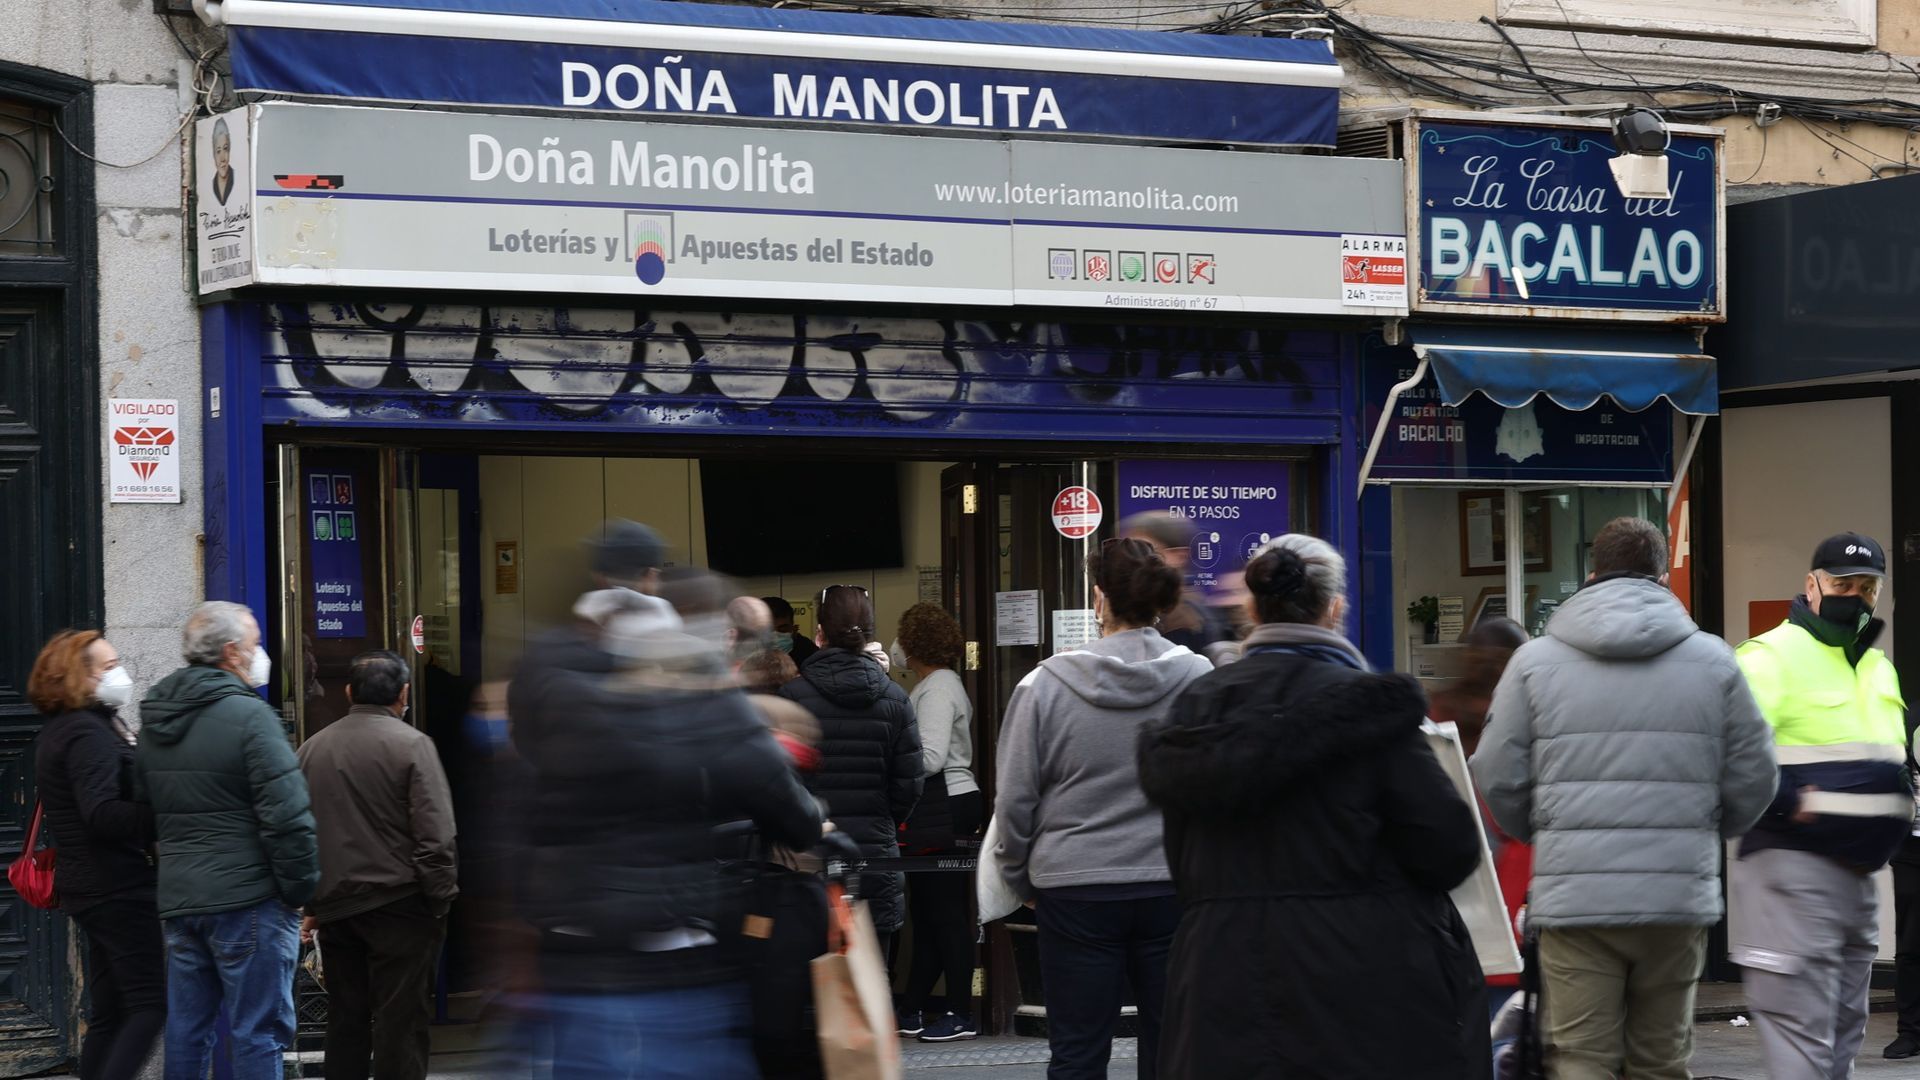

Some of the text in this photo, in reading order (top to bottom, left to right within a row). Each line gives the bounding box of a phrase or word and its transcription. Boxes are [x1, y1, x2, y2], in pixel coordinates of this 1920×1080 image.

[561, 56, 1068, 129] DOÑA MANOLITA
[468, 134, 815, 196] Doña Manolita
[1453, 155, 1508, 208] La
[1520, 158, 1607, 214] Casa
[935, 180, 1239, 214] www.loteriamanolita.com
[488, 226, 620, 262] Loterías y
[681, 234, 934, 269] Apuestas del Estado
[1342, 239, 1405, 252] ALARMA
[1431, 216, 1703, 288] BACALAO
[1372, 264, 1403, 273] LASSER
[1105, 294, 1187, 309] Administración
[1204, 297, 1218, 309] 67
[1347, 289, 1366, 299] 24h
[113, 404, 174, 415] VIGILADO
[1402, 406, 1459, 418] AUTENTICO
[1601, 414, 1614, 424] DE
[1399, 424, 1464, 442] BACALAO
[1575, 434, 1639, 445] IMPORTACION
[1061, 491, 1089, 509] +18
[1131, 485, 1276, 500] DISFRUTE DE SU TIEMPO
[1169, 506, 1240, 519] EN 3 PASOS
[316, 582, 351, 597] Loterías y
[317, 600, 362, 615] Apuestas del
[318, 619, 343, 630] Estado
